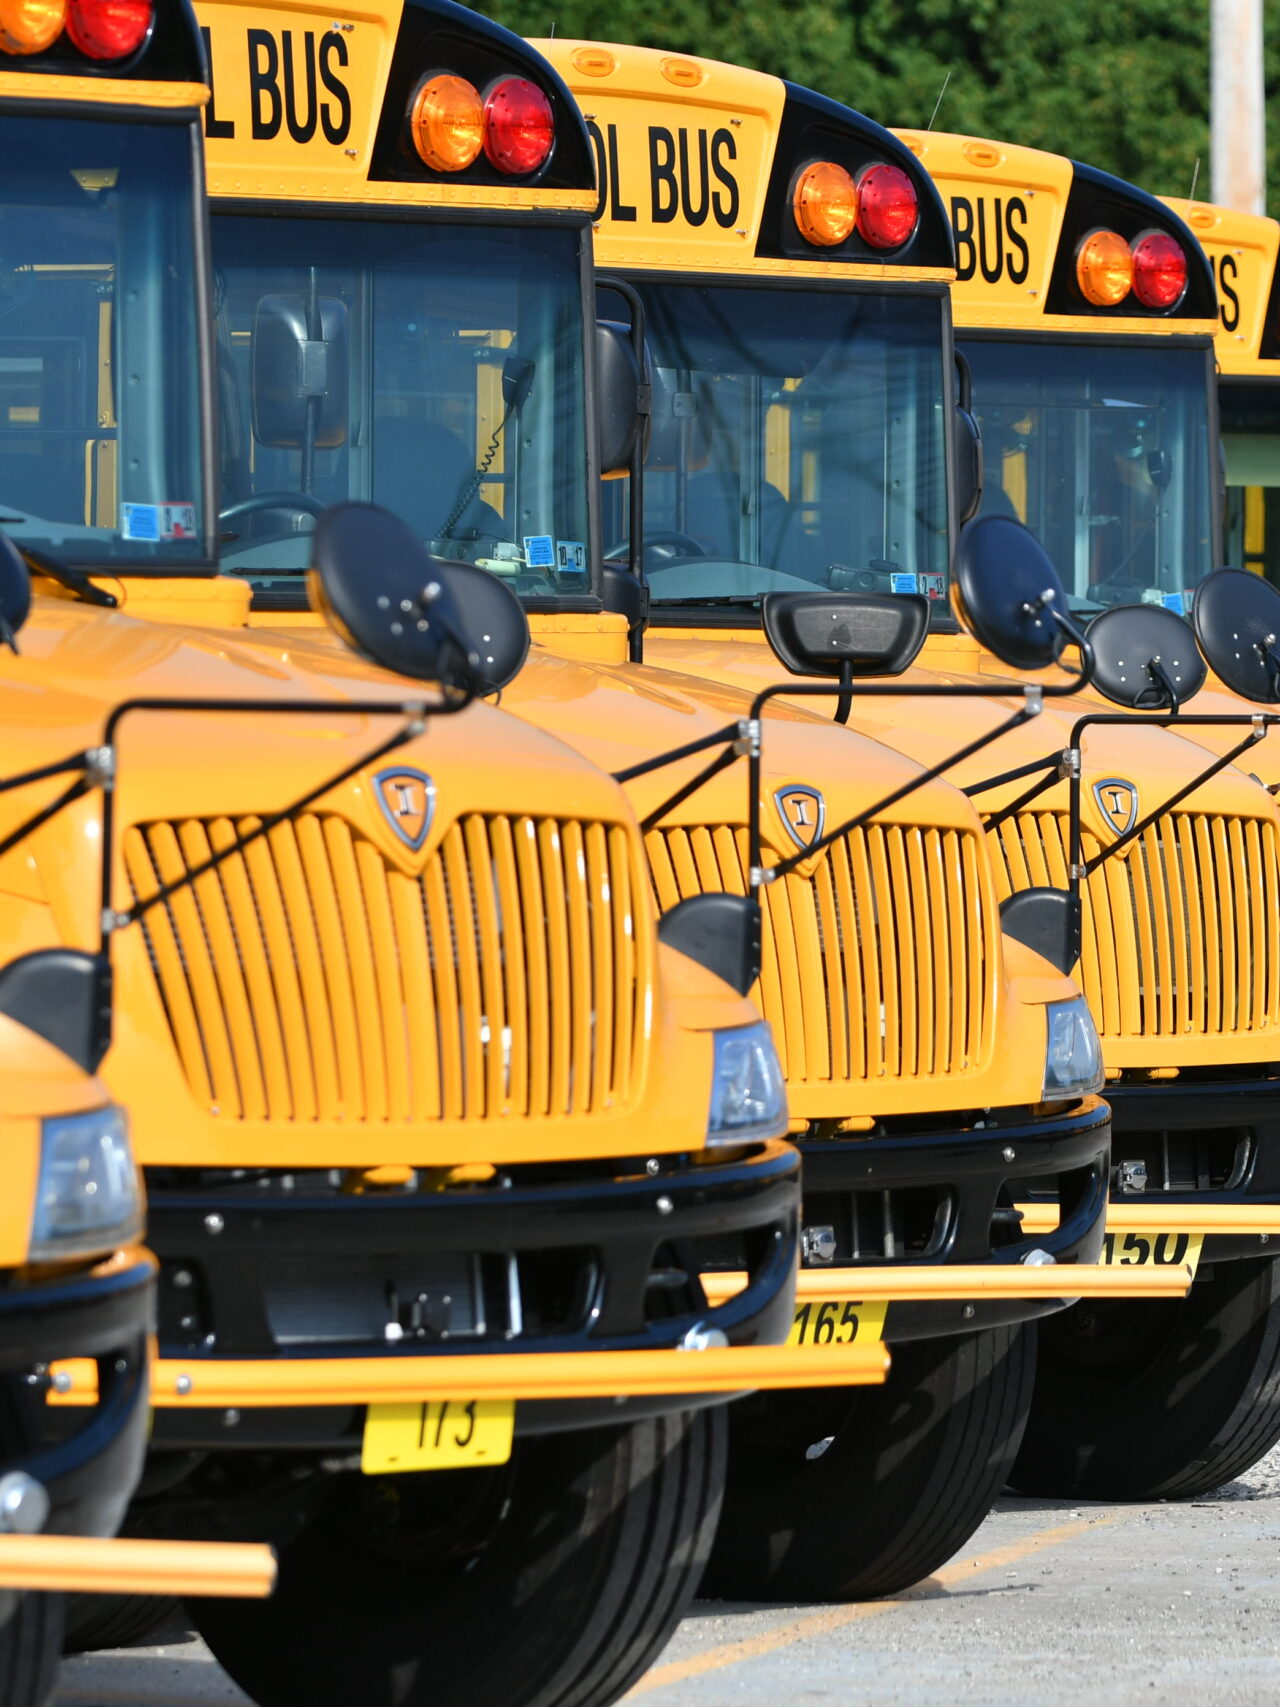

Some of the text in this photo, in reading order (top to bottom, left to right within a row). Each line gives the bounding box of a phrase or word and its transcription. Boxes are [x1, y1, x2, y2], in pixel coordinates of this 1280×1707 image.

[247, 28, 351, 145] BUS
[648, 126, 740, 228] BUS
[950, 196, 1029, 285] BUS
[1102, 1232, 1190, 1265] 150
[794, 1301, 863, 1346] 165
